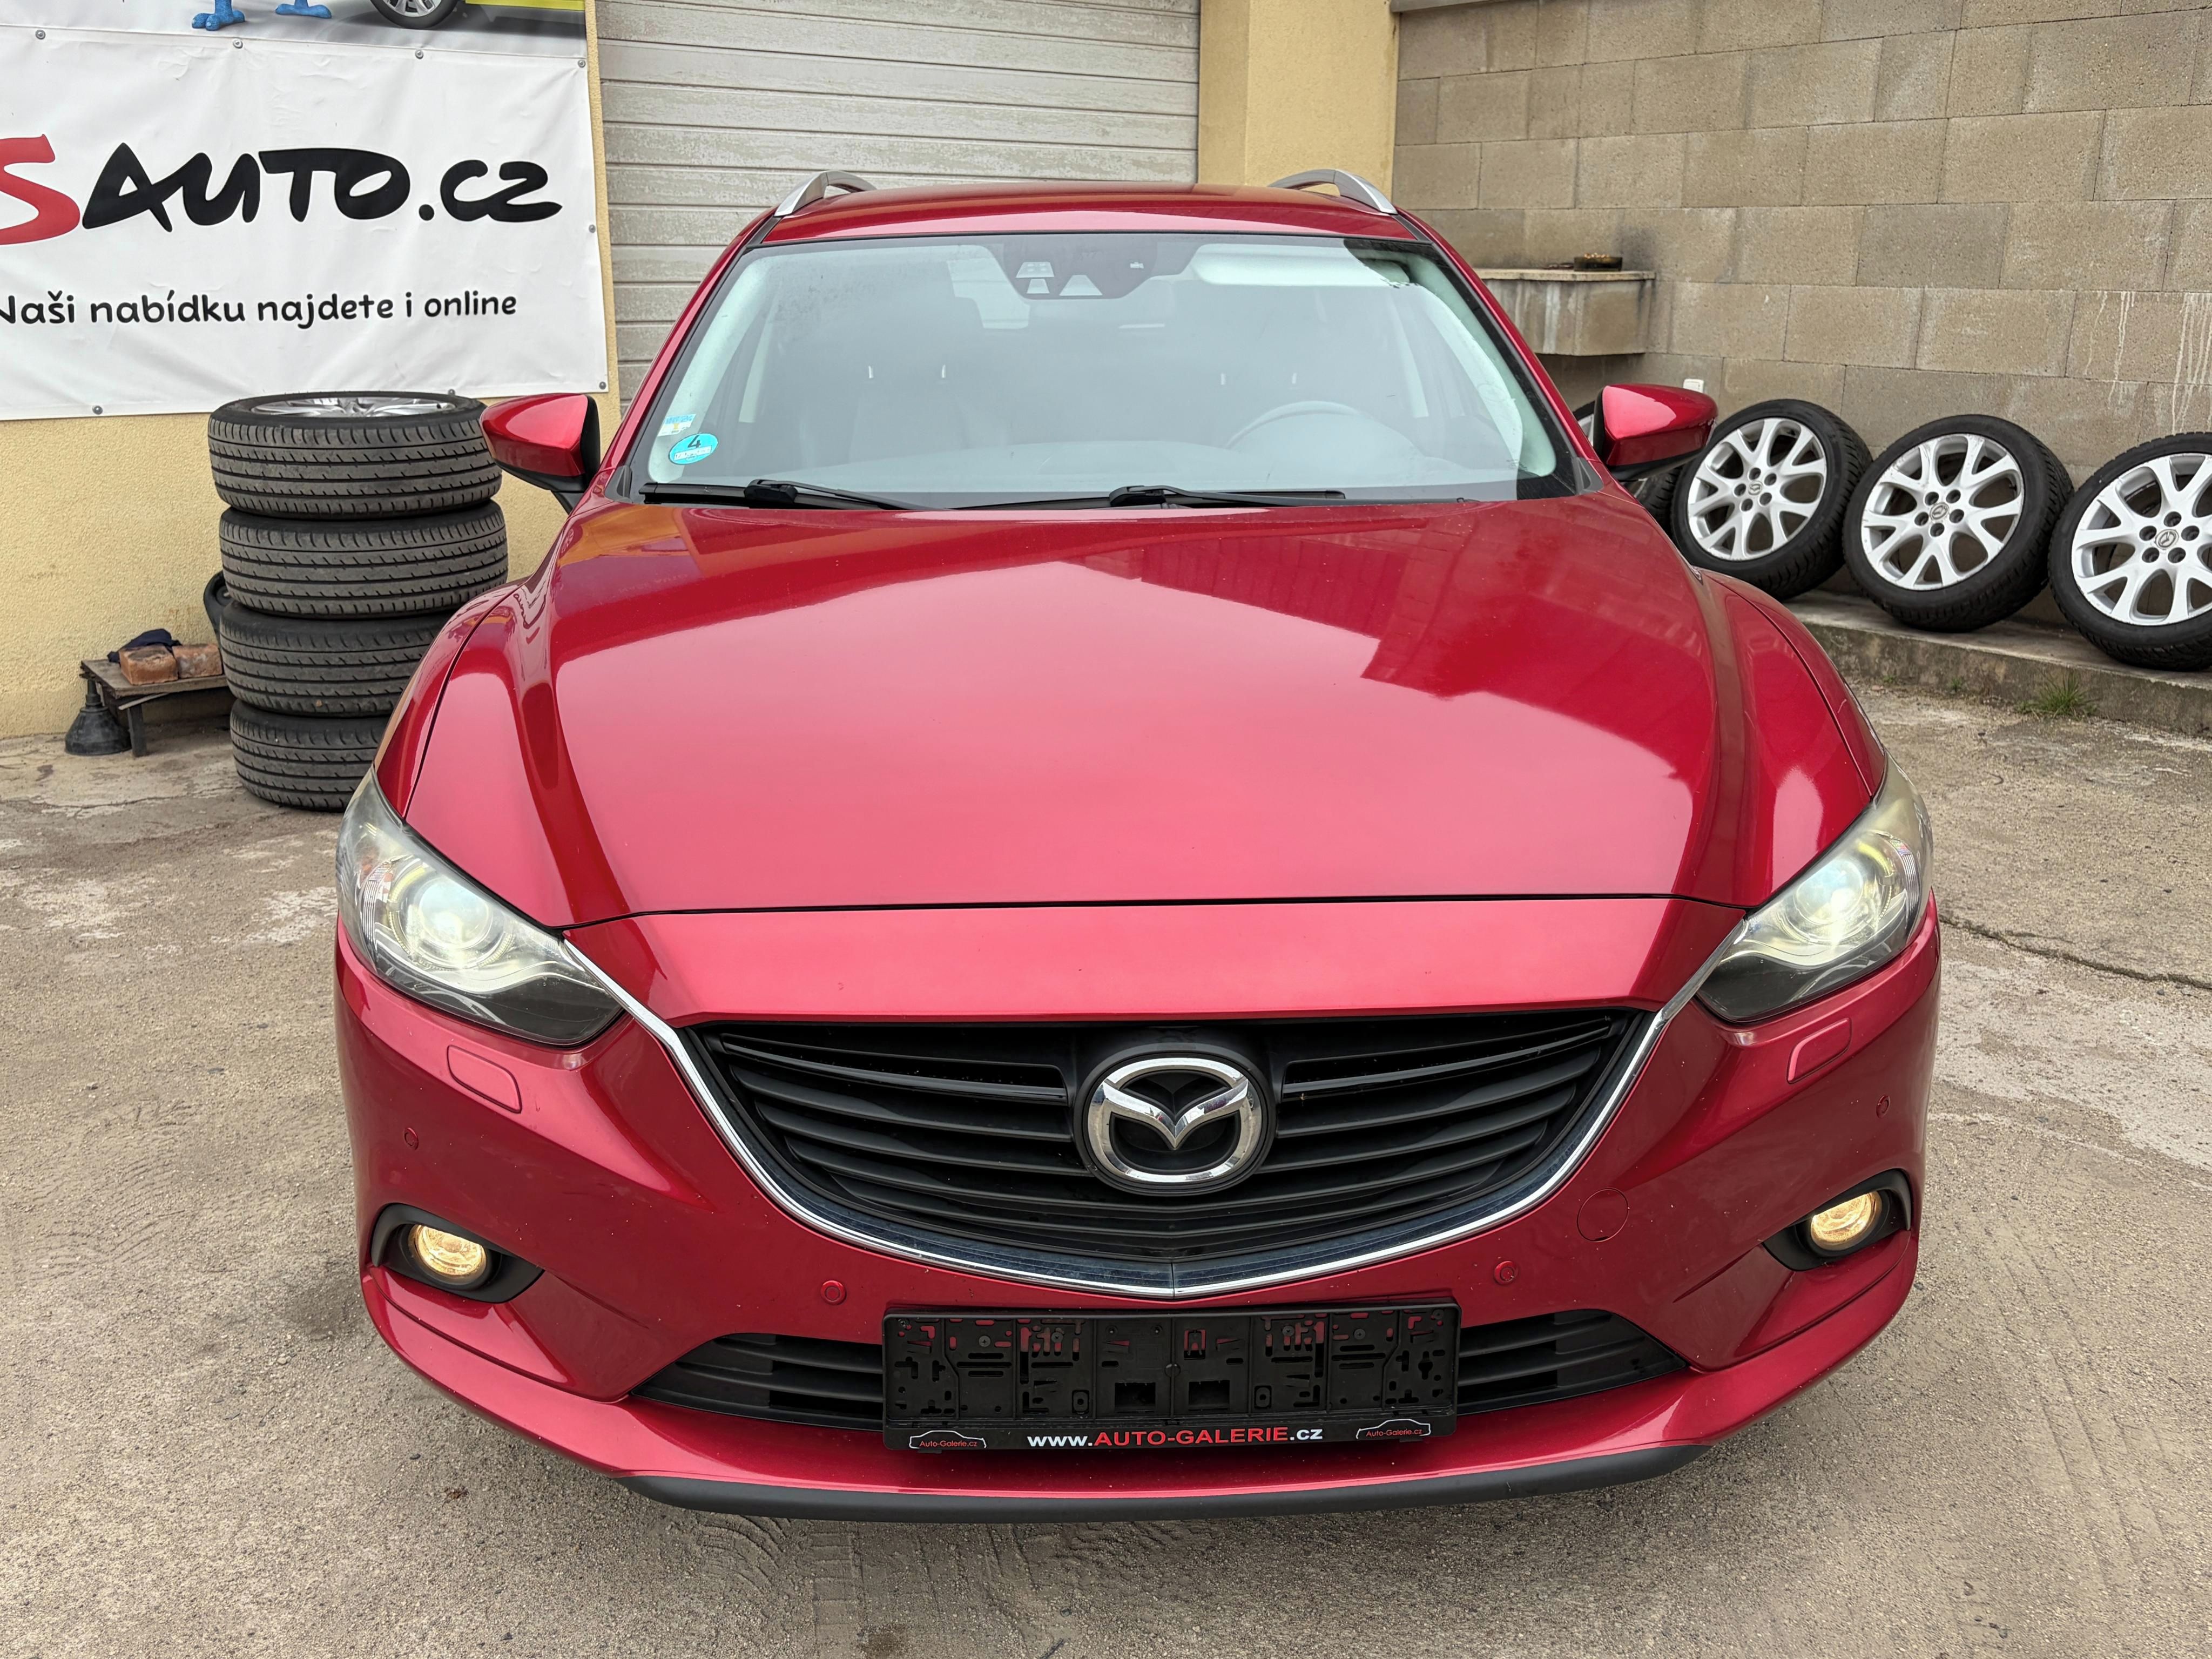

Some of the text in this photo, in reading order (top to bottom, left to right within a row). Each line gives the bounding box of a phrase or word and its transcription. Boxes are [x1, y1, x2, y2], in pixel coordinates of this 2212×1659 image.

[90, 289, 245, 323] nabídku
[258, 293, 393, 329] najdete
[406, 292, 412, 318] i
[424, 291, 517, 318] online
[687, 435, 701, 448] 4
[1027, 1427, 1323, 1447] www.AUTO-GALERIE.cz
[1366, 1429, 1422, 1437] Auto-Galerie.cz
[919, 1440, 978, 1448] Auto-Galerie.cz
